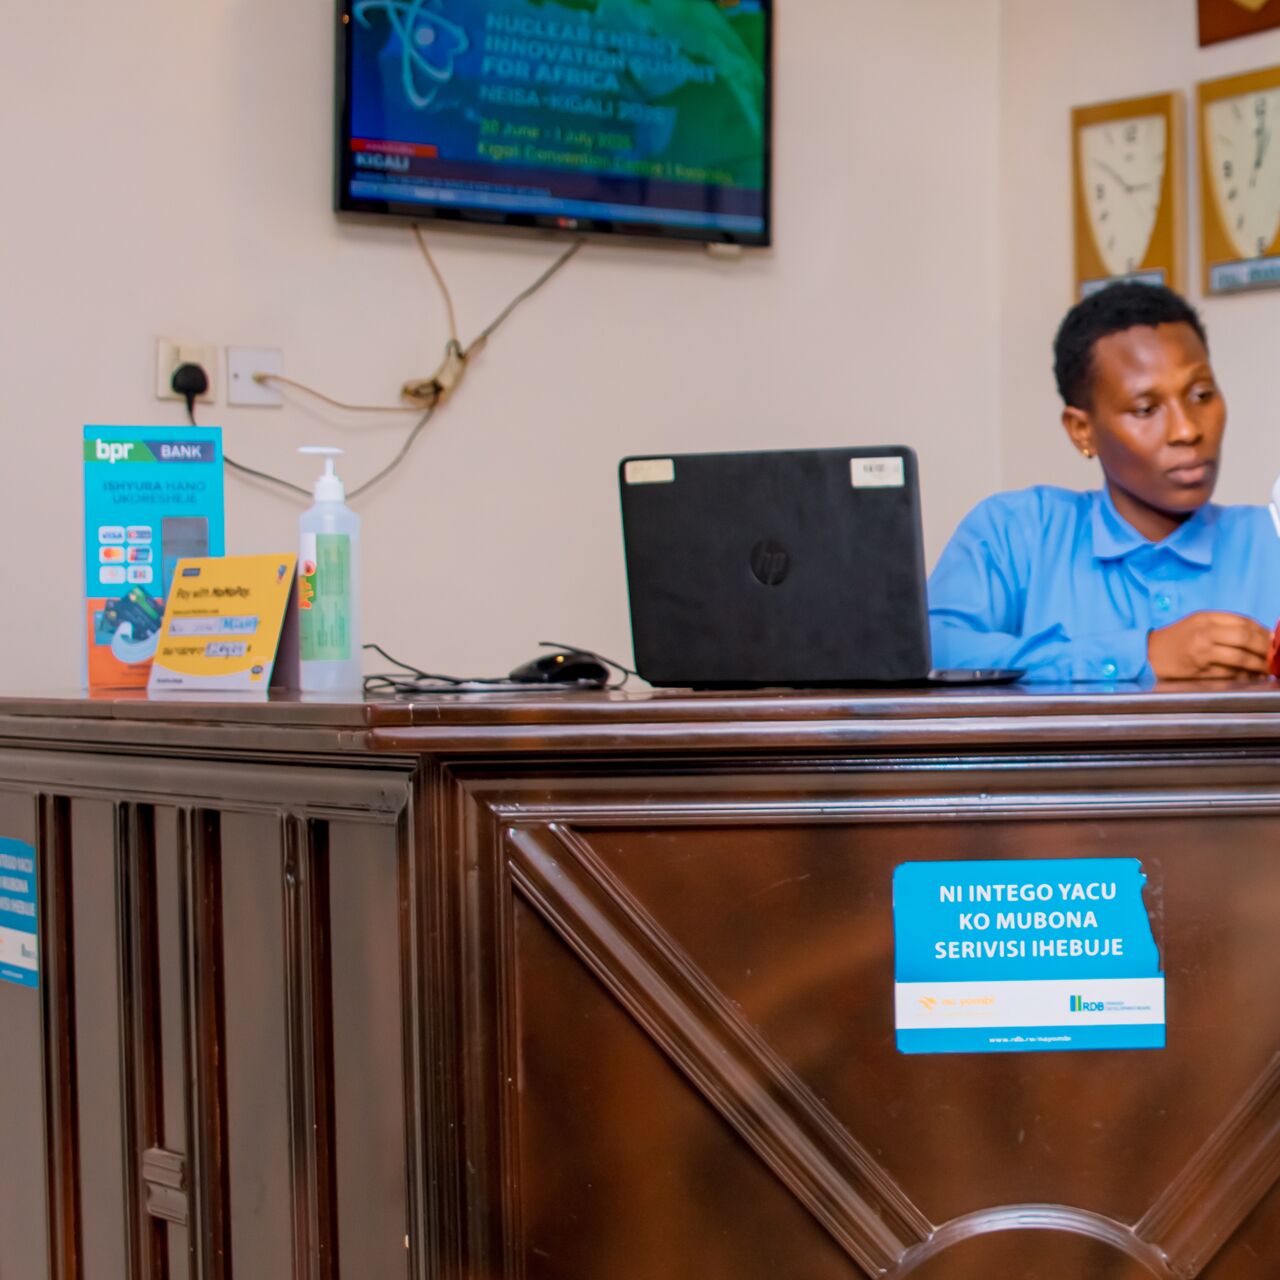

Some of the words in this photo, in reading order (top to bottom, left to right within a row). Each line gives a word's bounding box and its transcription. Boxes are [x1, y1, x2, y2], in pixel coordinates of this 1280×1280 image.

[486, 13, 590, 43] NUCLEAR
[595, 30, 681, 57] ENERGY
[485, 35, 625, 68] INNOVATION
[629, 57, 716, 84] SUMMIT
[481, 55, 531, 78] FOR
[535, 62, 620, 91] AFRICA
[355, 151, 411, 170] KIGALI
[95, 438, 134, 464] bpr
[160, 444, 202, 458] BANK
[103, 481, 161, 492] ISHYURA
[166, 481, 206, 492] HANO
[940, 885, 962, 902] NI
[969, 884, 1053, 903] INTEGO
[1058, 882, 1116, 900] YACU
[959, 913, 990, 930] KO
[996, 911, 1098, 930] MUBONA
[935, 940, 1025, 959] SERIVISI
[1032, 938, 1123, 957] IHEBUJE
[1082, 1001, 1105, 1012] RDB
